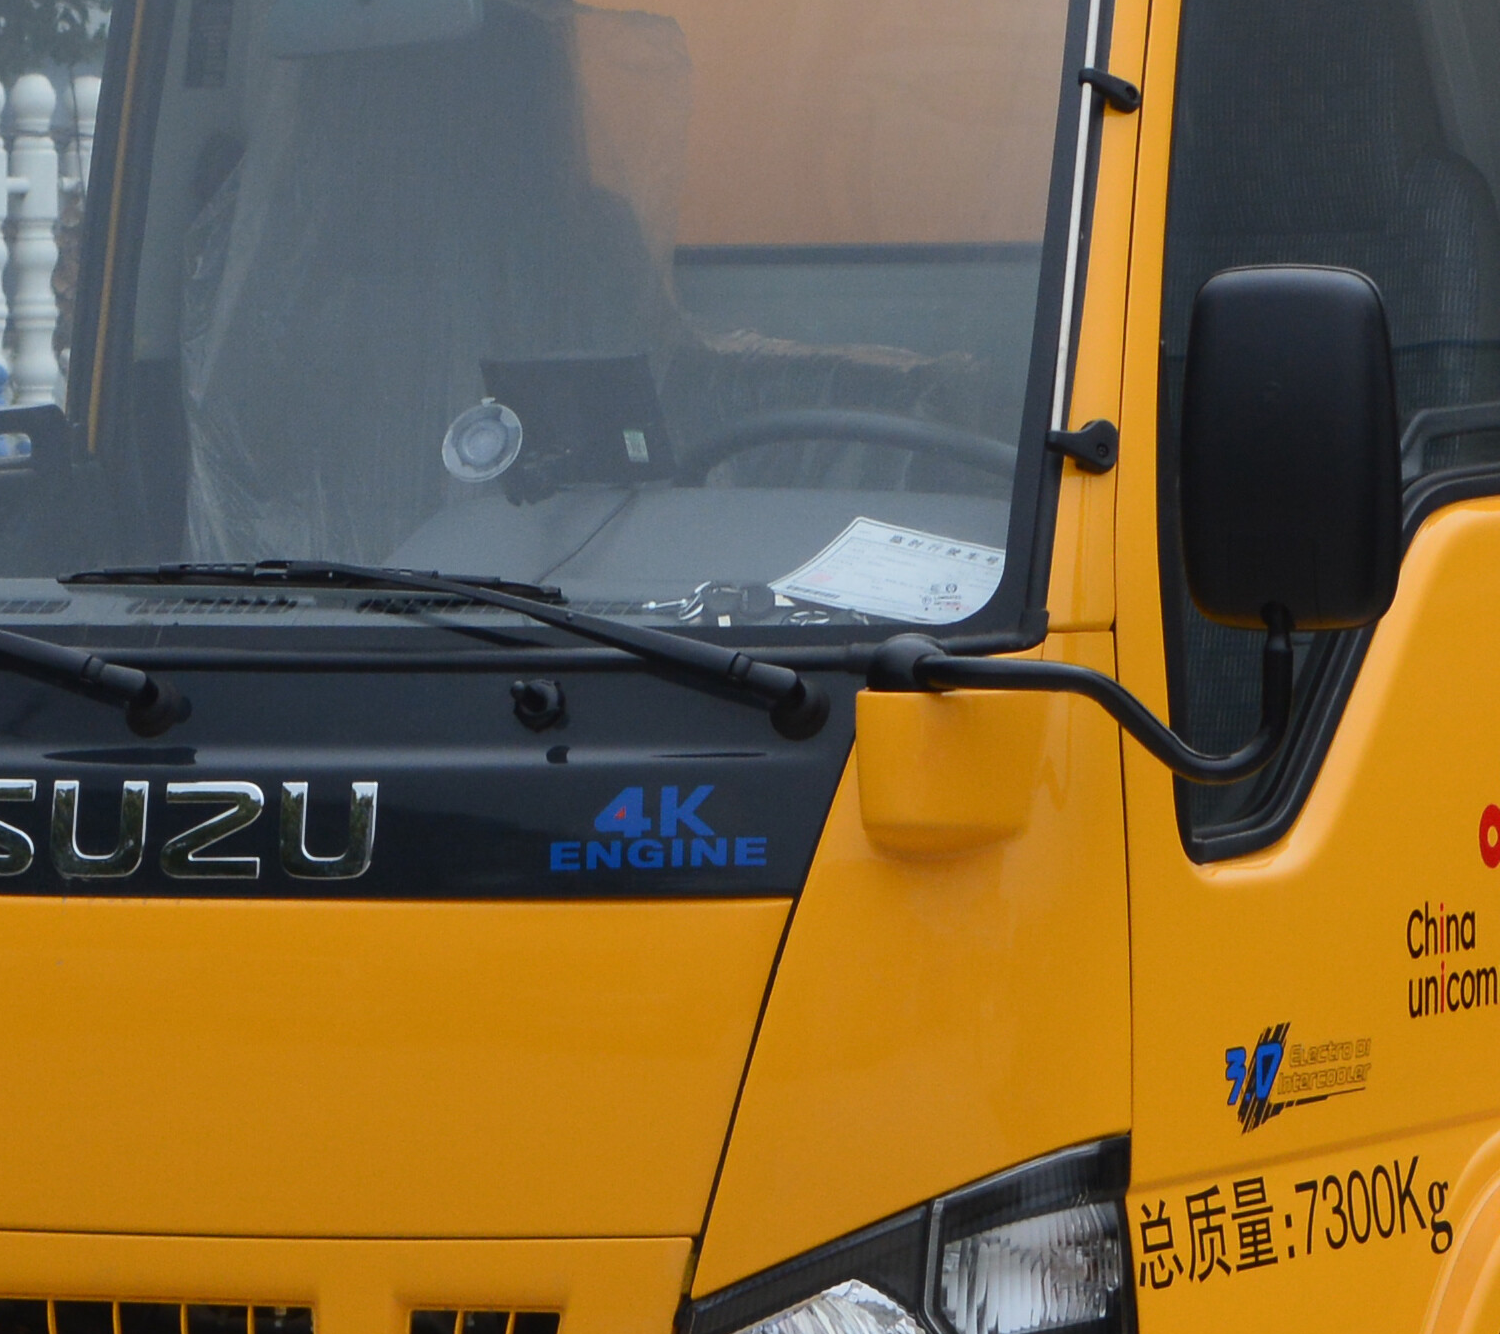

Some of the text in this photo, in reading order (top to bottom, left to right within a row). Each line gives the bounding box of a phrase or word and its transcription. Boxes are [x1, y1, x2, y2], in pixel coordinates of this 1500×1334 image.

[594, 784, 715, 838] 4K
[550, 837, 768, 872] ENGINE
[1406, 901, 1476, 959] China
